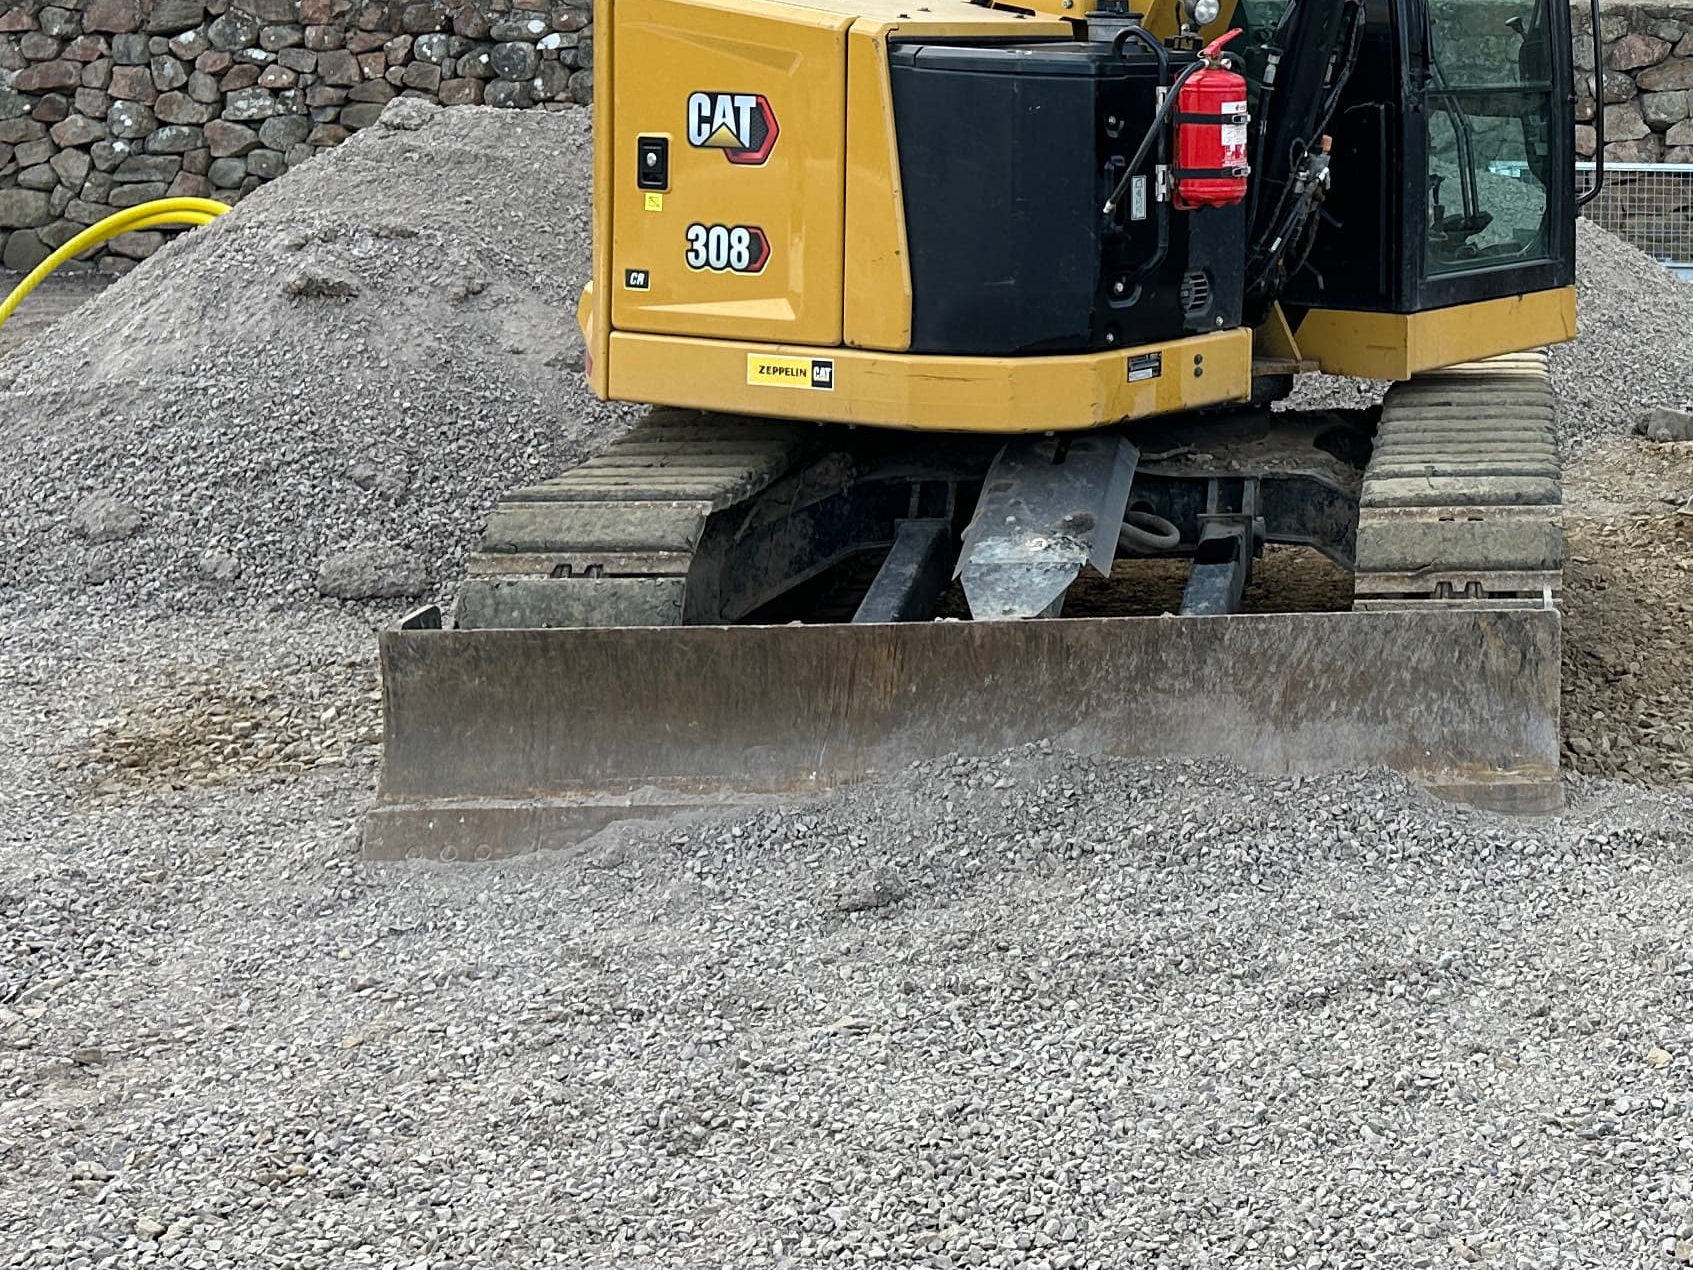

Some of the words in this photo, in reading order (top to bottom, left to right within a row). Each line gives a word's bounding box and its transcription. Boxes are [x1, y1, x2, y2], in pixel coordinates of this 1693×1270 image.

[688, 92, 757, 148] CAT
[687, 224, 751, 270] 308
[758, 364, 808, 378] ZEPPELIN
[812, 365, 833, 382] CAT
